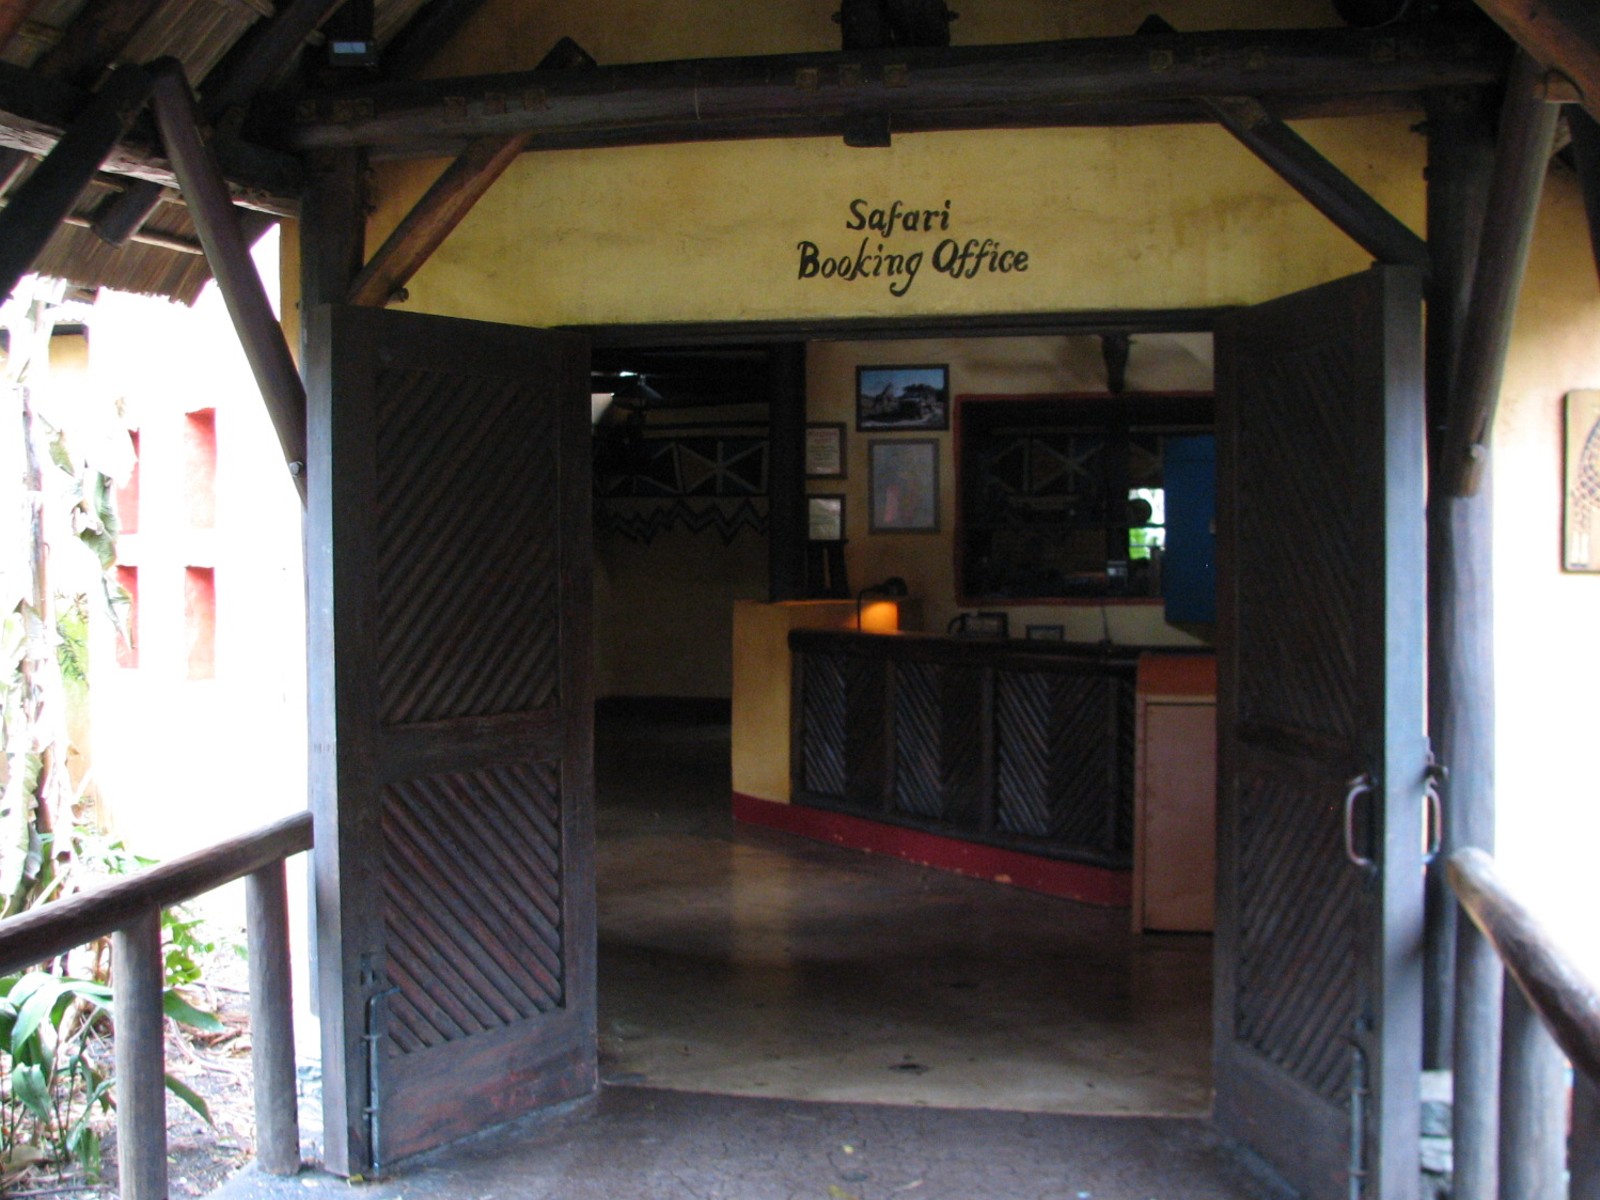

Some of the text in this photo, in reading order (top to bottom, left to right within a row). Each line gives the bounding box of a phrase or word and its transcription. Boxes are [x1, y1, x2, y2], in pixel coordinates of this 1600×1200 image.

[846, 198, 951, 238] Safari
[797, 237, 1028, 297] Booking Office
